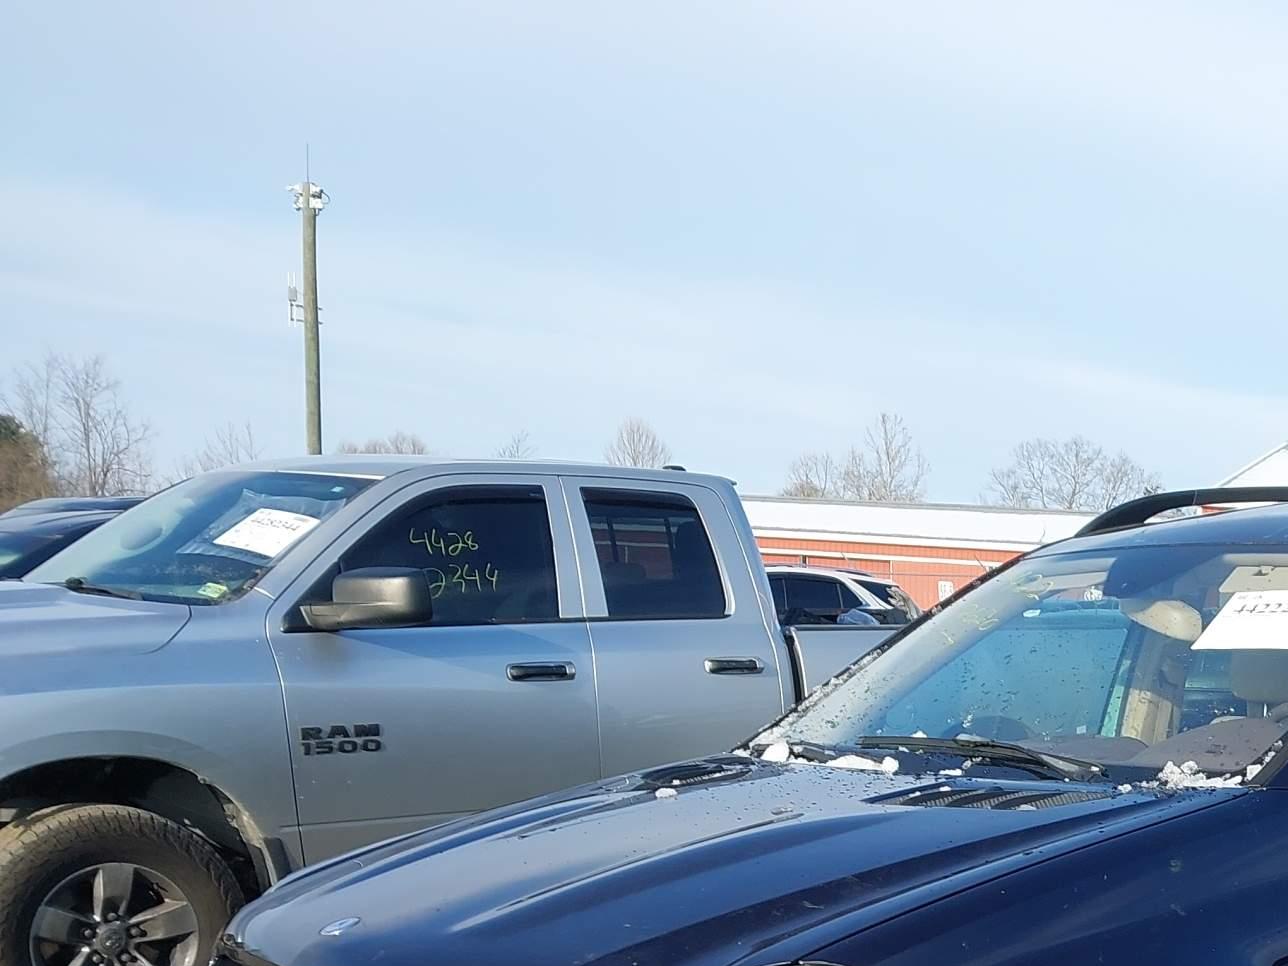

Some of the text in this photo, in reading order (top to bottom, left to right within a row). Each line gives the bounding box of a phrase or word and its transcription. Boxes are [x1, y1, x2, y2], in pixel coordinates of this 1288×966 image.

[409, 528, 479, 556] 4428
[422, 563, 498, 600] 2344
[301, 723, 380, 740] RAM
[302, 739, 382, 756] 1500
